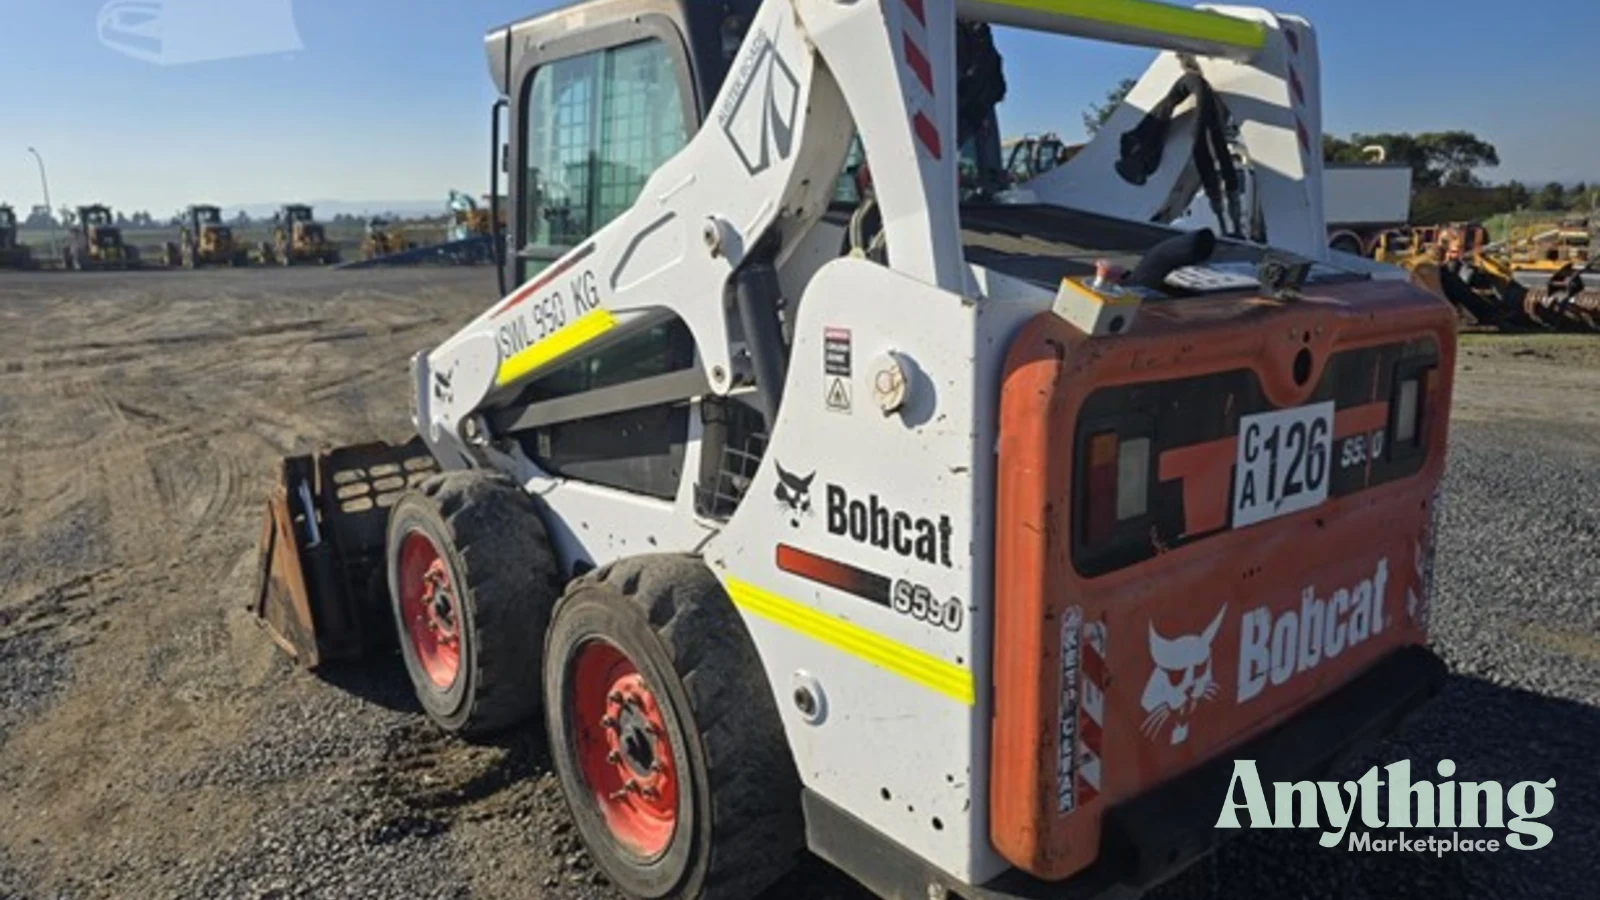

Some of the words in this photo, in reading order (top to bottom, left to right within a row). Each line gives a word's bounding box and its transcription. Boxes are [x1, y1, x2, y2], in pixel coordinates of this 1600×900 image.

[533, 291, 565, 338] 950
[570, 269, 600, 317] KG
[1264, 417, 1328, 502] 126
[1340, 430, 1386, 470] S50
[826, 483, 953, 568] Bobcat
[893, 578, 963, 632] S590
[1237, 557, 1389, 702] Bobcat
